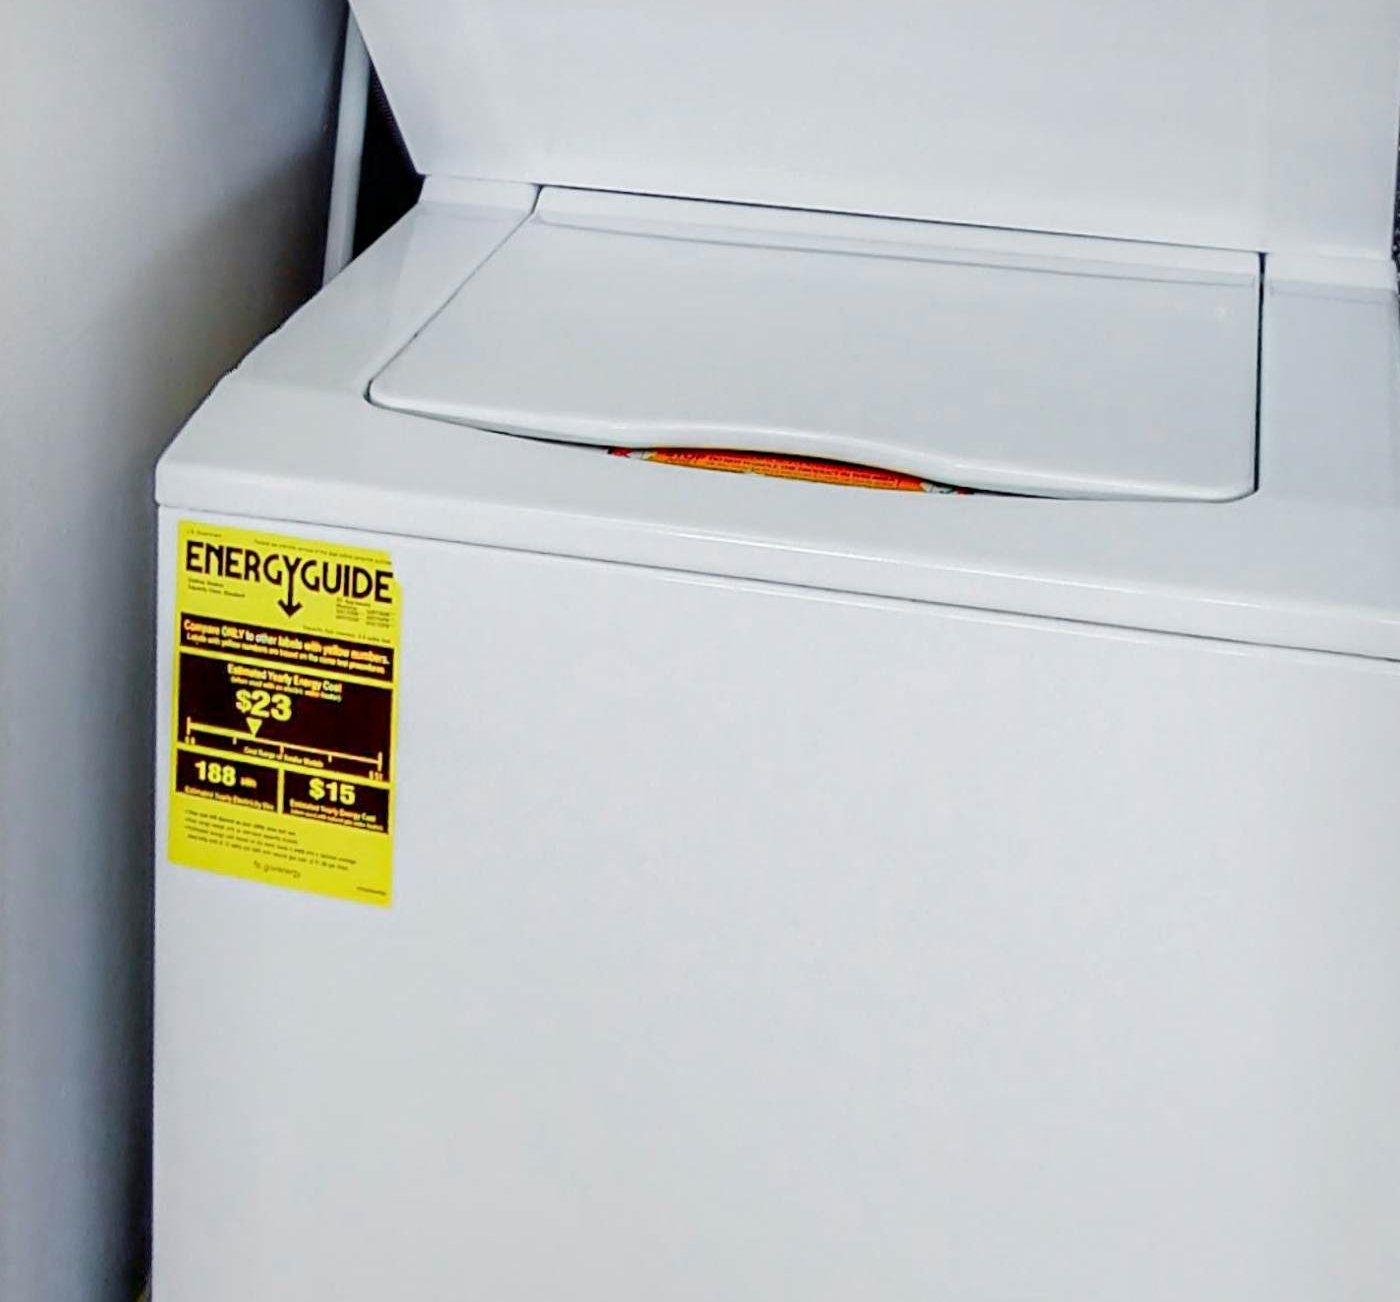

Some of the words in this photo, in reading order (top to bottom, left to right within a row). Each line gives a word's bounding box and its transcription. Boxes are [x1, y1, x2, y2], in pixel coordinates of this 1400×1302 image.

[185, 539, 394, 606] ENERGYGUIDE
[268, 670, 292, 687] Yearly
[293, 675, 322, 692] Energy
[323, 679, 342, 694] Cost
[235, 688, 292, 722] $23
[194, 759, 237, 788] 188
[308, 776, 356, 806] $15
